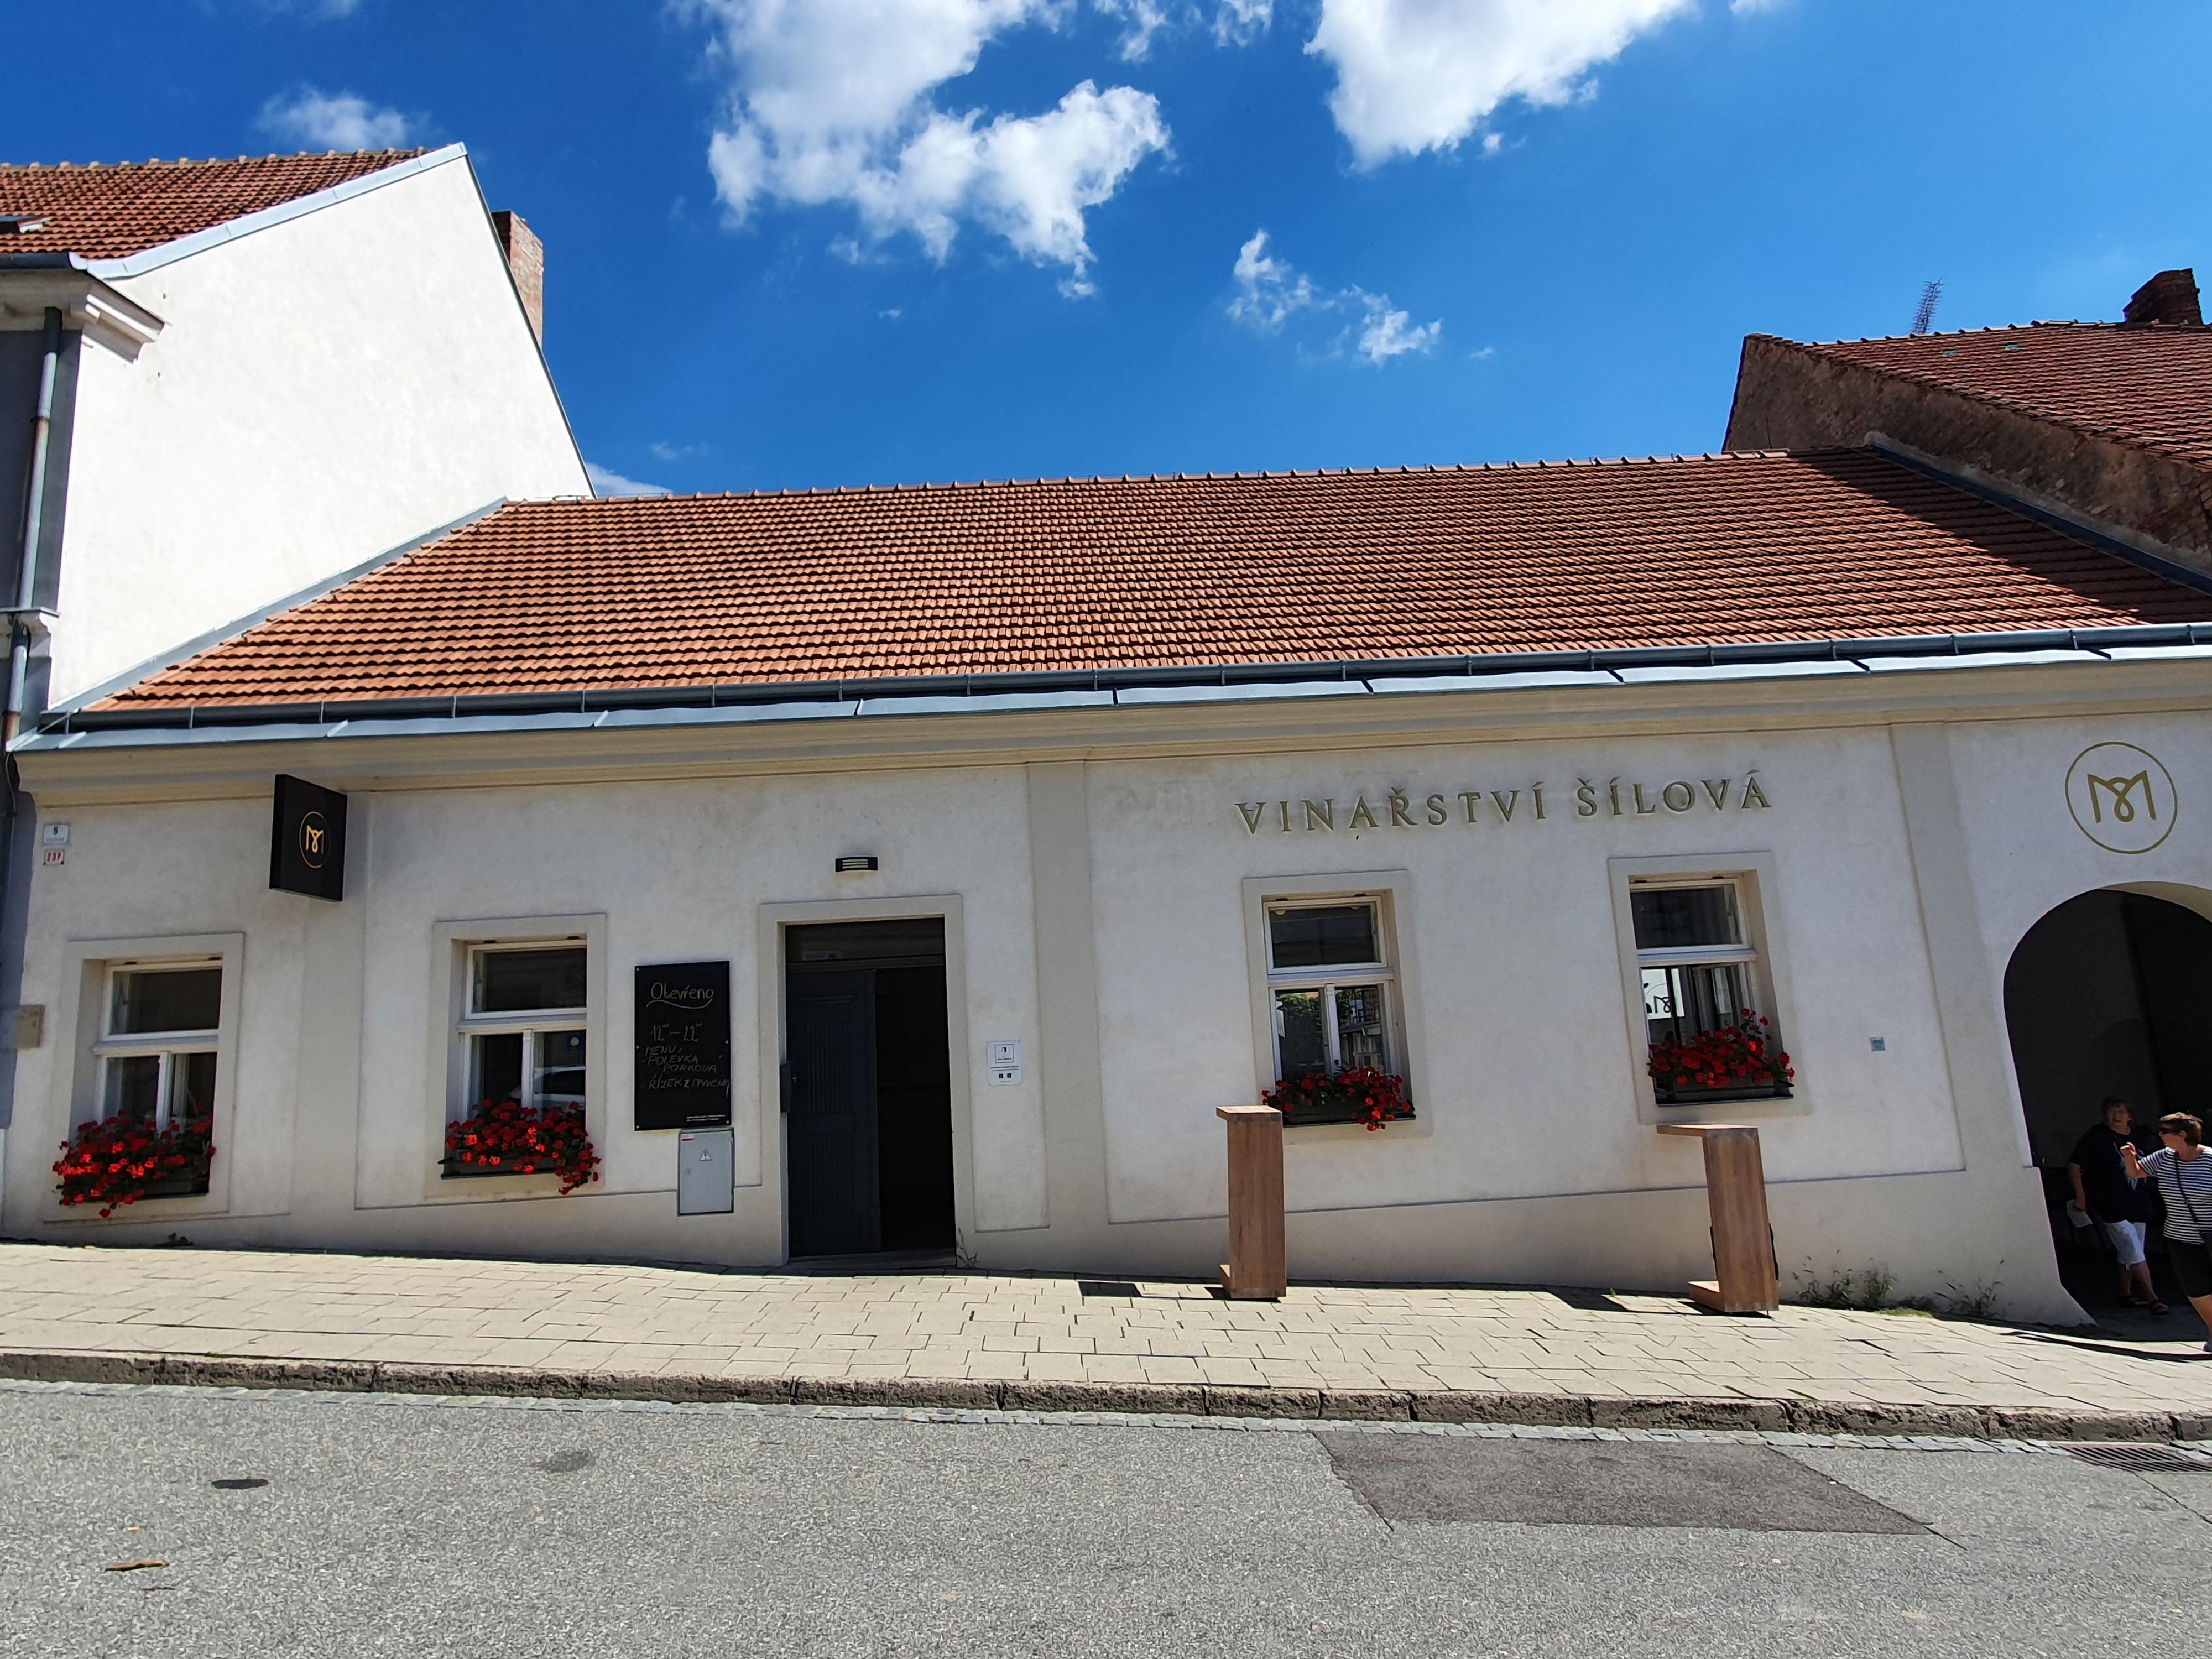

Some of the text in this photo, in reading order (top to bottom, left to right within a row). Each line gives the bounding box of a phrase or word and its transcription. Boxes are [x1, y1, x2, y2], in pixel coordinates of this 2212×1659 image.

[1234, 769, 1771, 835] VINAŘSTVÍ ŠÍLOVÁ
[651, 982, 714, 1000] Otevřeno
